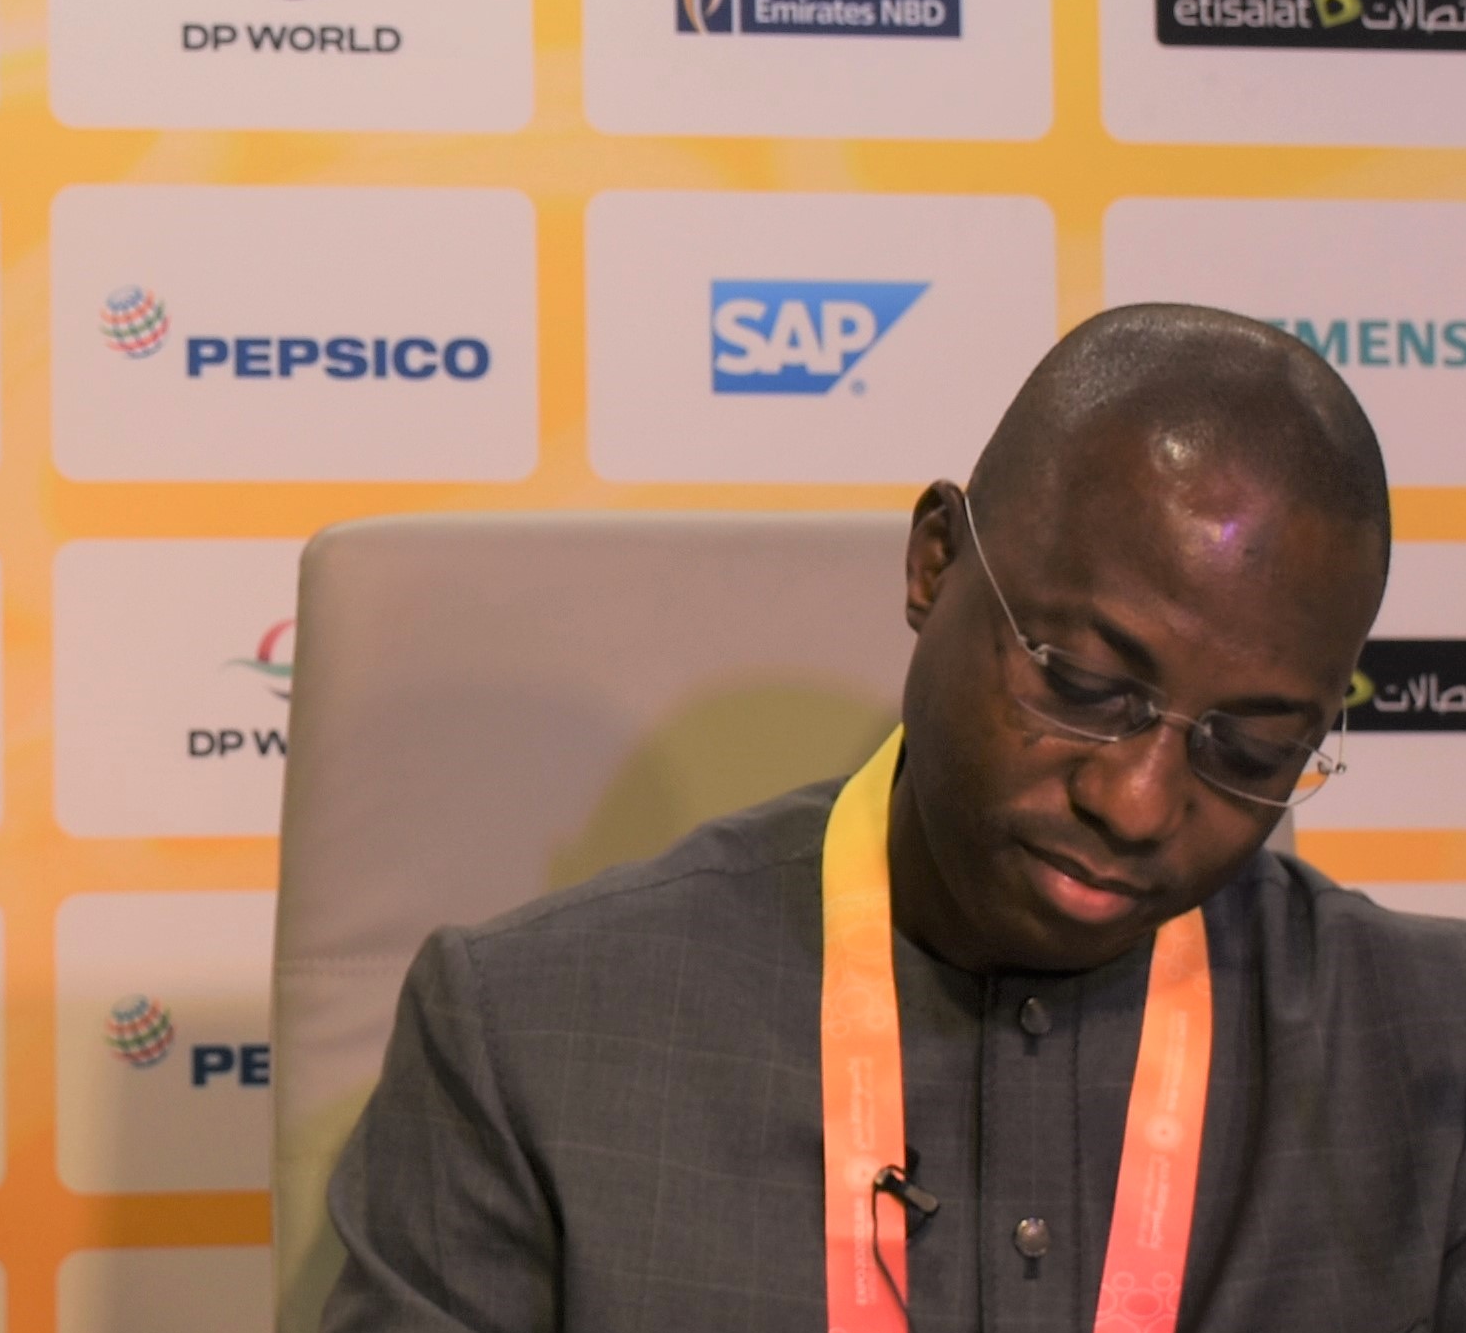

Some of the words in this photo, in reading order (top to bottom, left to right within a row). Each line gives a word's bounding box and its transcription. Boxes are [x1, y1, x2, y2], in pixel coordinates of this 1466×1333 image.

[182, 24, 238, 50] DP
[247, 25, 401, 53] WORLD
[713, 300, 877, 375] SAP
[187, 337, 490, 380] PEPSICO
[189, 730, 244, 757] DP
